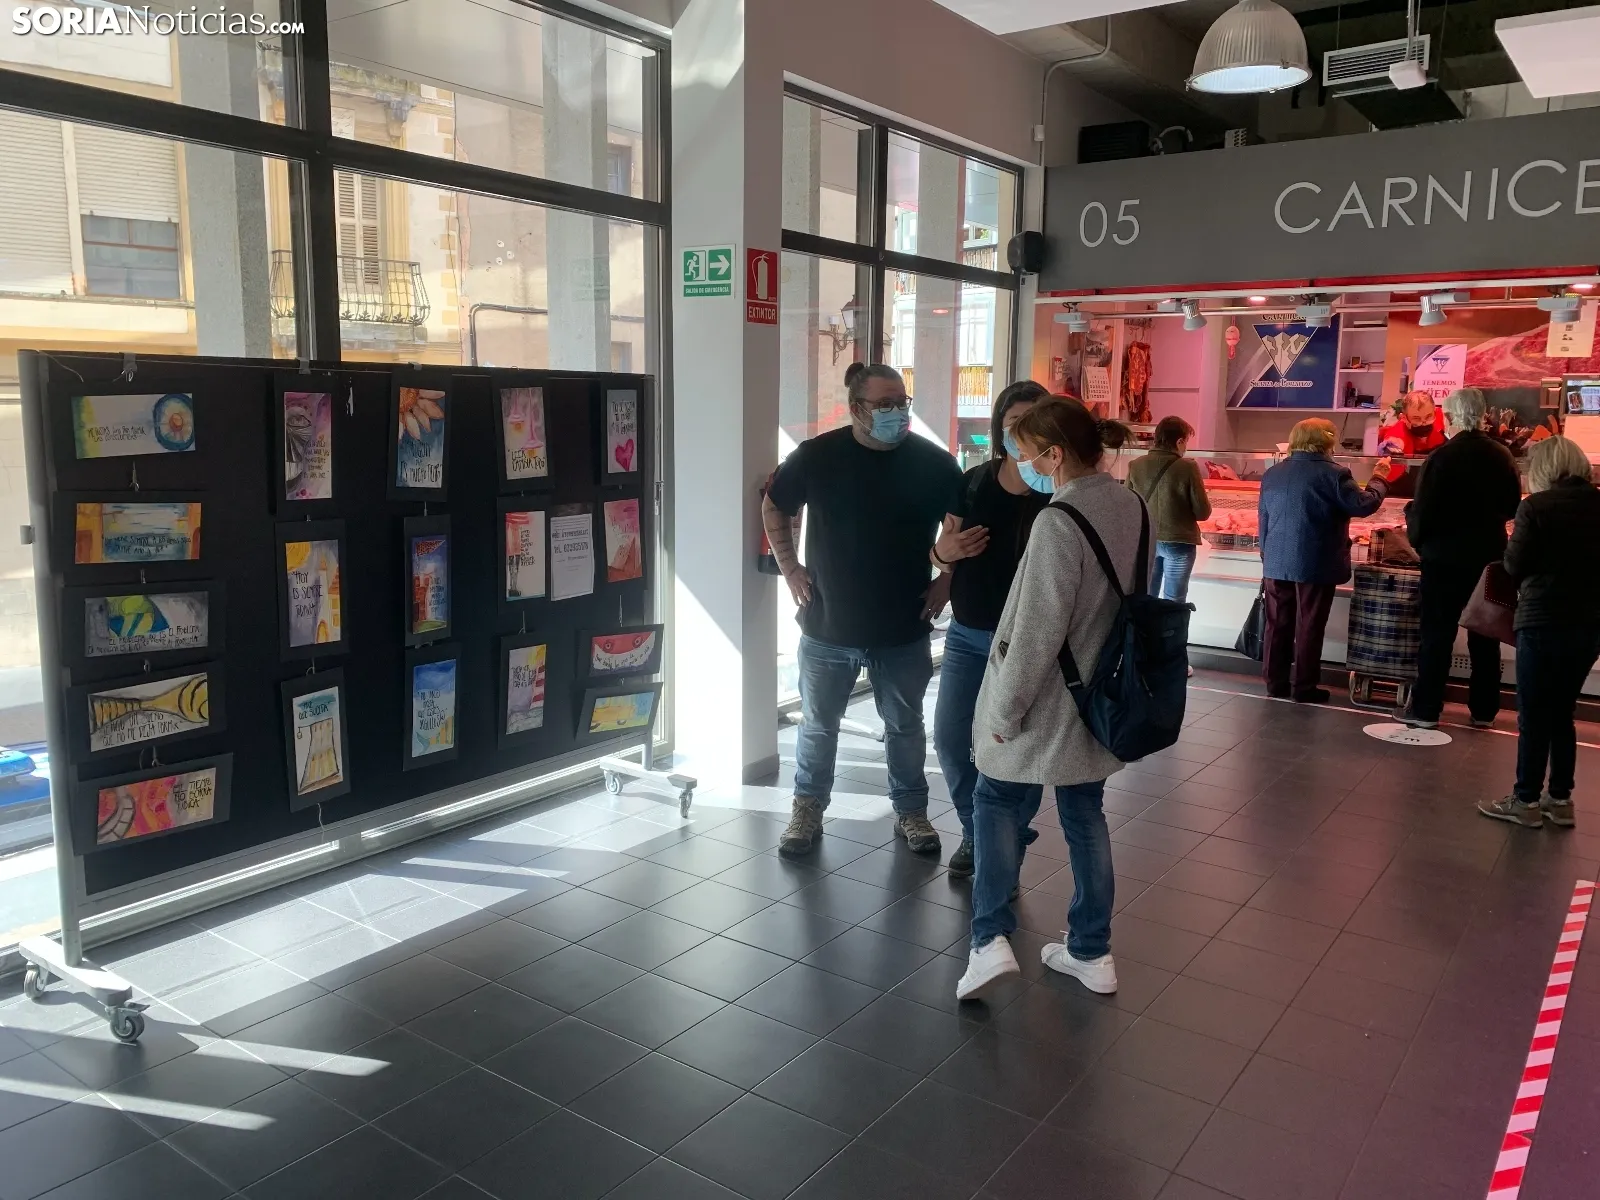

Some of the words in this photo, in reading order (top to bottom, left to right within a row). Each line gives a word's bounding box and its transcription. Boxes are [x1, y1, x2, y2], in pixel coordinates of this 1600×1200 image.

[1079, 199, 1141, 248] 05
[1274, 159, 1600, 234] CARNICE
[748, 305, 776, 320] EXTINTOR
